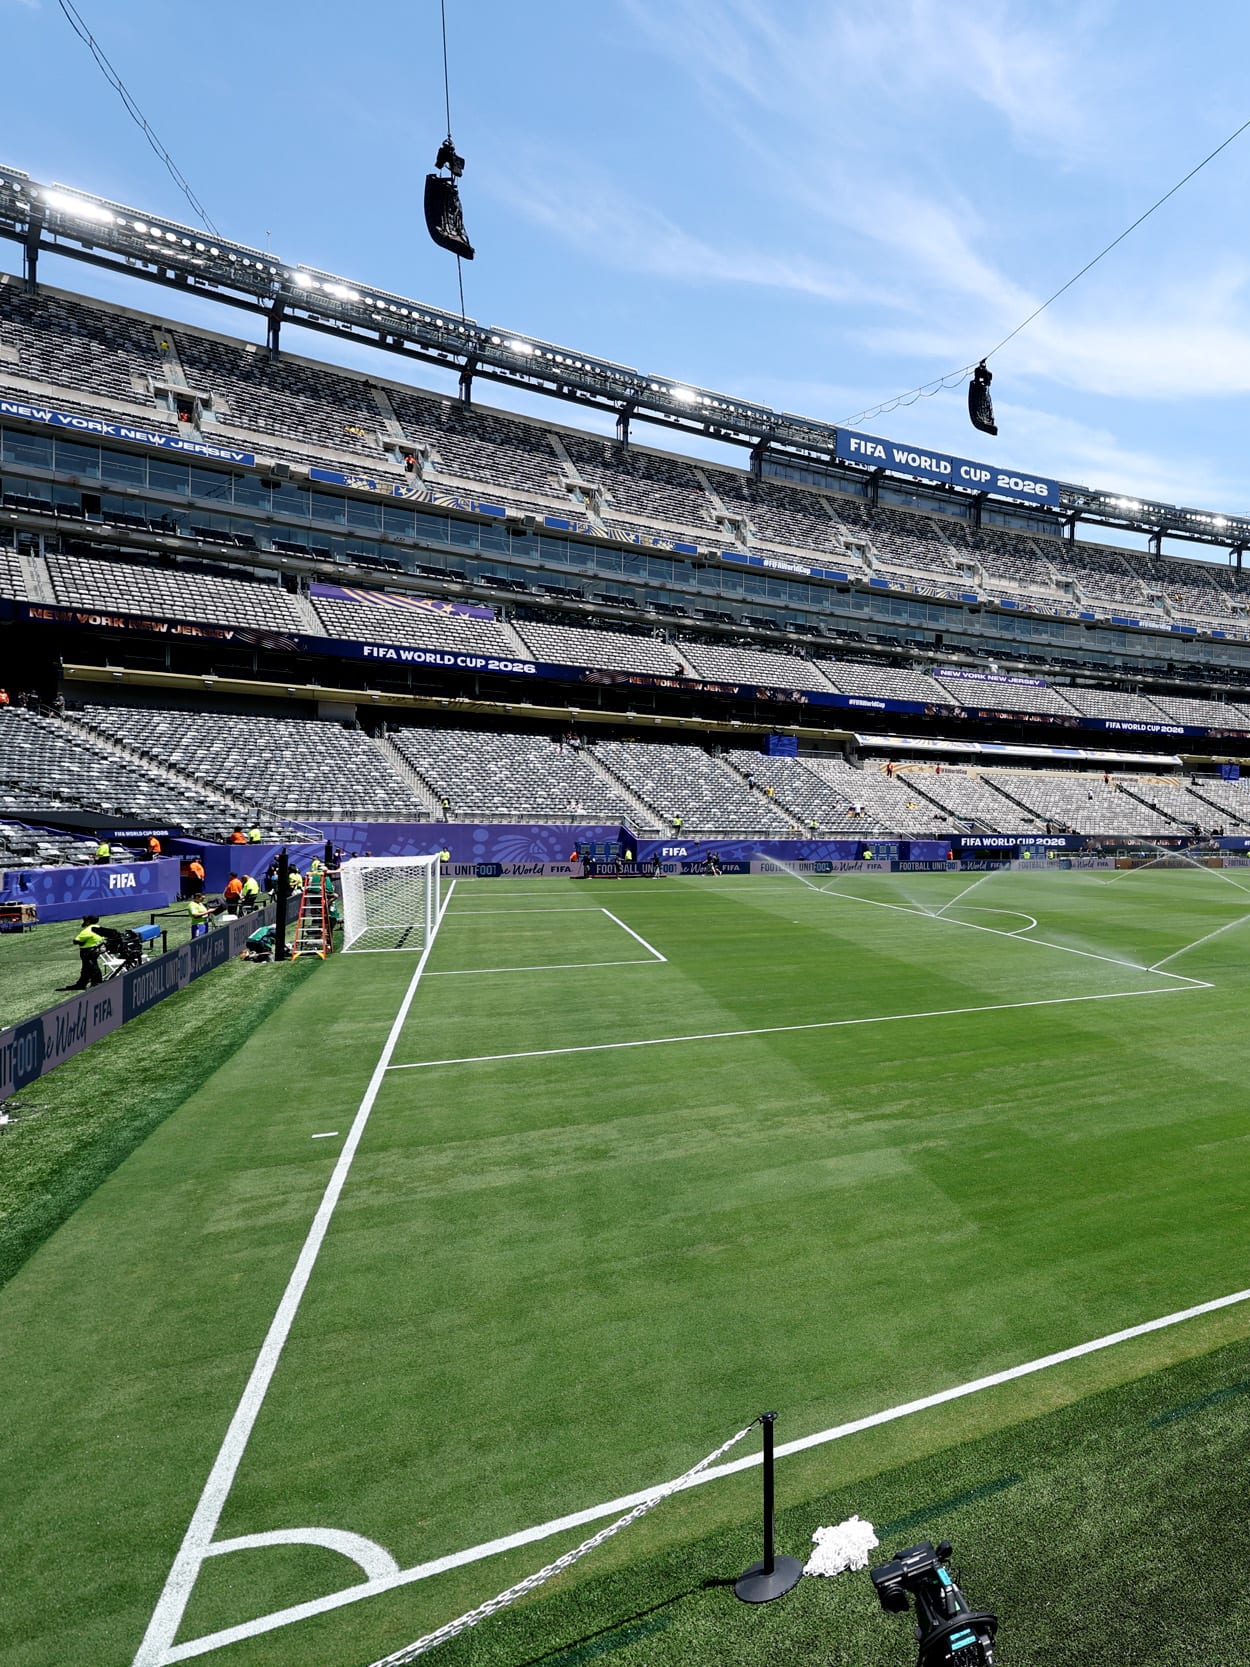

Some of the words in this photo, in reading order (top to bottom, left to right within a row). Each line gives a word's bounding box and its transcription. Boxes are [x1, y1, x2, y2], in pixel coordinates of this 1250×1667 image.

[1, 402, 52, 420] NEW
[55, 416, 115, 435] YORK
[121, 428, 166, 445] NEW
[170, 440, 244, 461] JERSEY
[850, 437, 887, 459] FIFA
[893, 448, 951, 474] WORLD
[960, 465, 991, 483] CUP
[997, 474, 1049, 497] 2026
[76, 612, 125, 628] YORK
[363, 645, 398, 660] FIFA
[400, 649, 455, 666] WORLD
[457, 656, 486, 669] CUP
[488, 660, 536, 674] 2026
[962, 672, 986, 680] YORK
[1008, 677, 1040, 686] JERSEY
[1105, 721, 1121, 730] FIFA
[1121, 722, 1146, 731] WORLD
[1147, 724, 1161, 733] CUP
[1161, 726, 1185, 734] 2026
[961, 838, 980, 846] FIFA
[980, 838, 1016, 846] WORLD
[1036, 838, 1066, 846] 2026
[662, 847, 688, 857] FIFA
[513, 863, 545, 876] World
[840, 862, 863, 873] World
[900, 861, 931, 871] FOOTBALL
[109, 872, 136, 890] FIFA
[214, 939, 224, 957] FIFA
[55, 1000, 89, 1057] World
[93, 997, 113, 1026] FIFA
